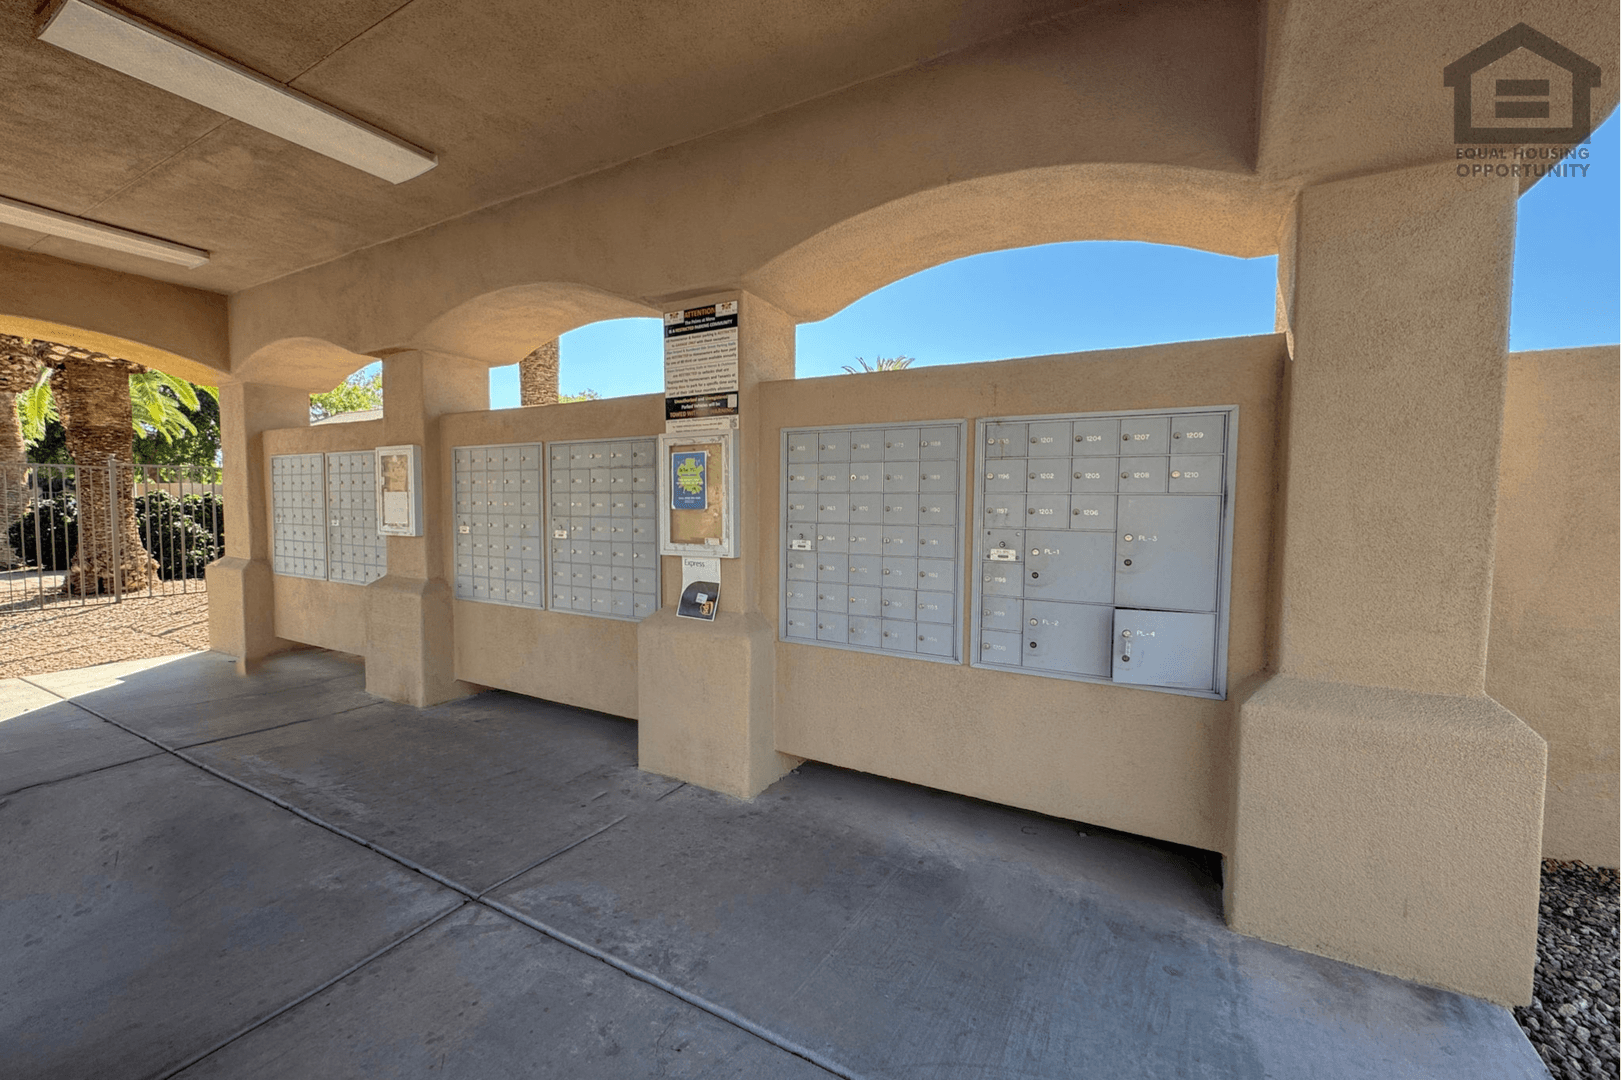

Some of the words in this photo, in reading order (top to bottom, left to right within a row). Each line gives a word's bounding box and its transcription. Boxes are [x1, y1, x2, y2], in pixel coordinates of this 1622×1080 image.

[684, 307, 715, 318] ATTENTION
[710, 319, 732, 327] COMMUNITY
[685, 559, 705, 568] Express
